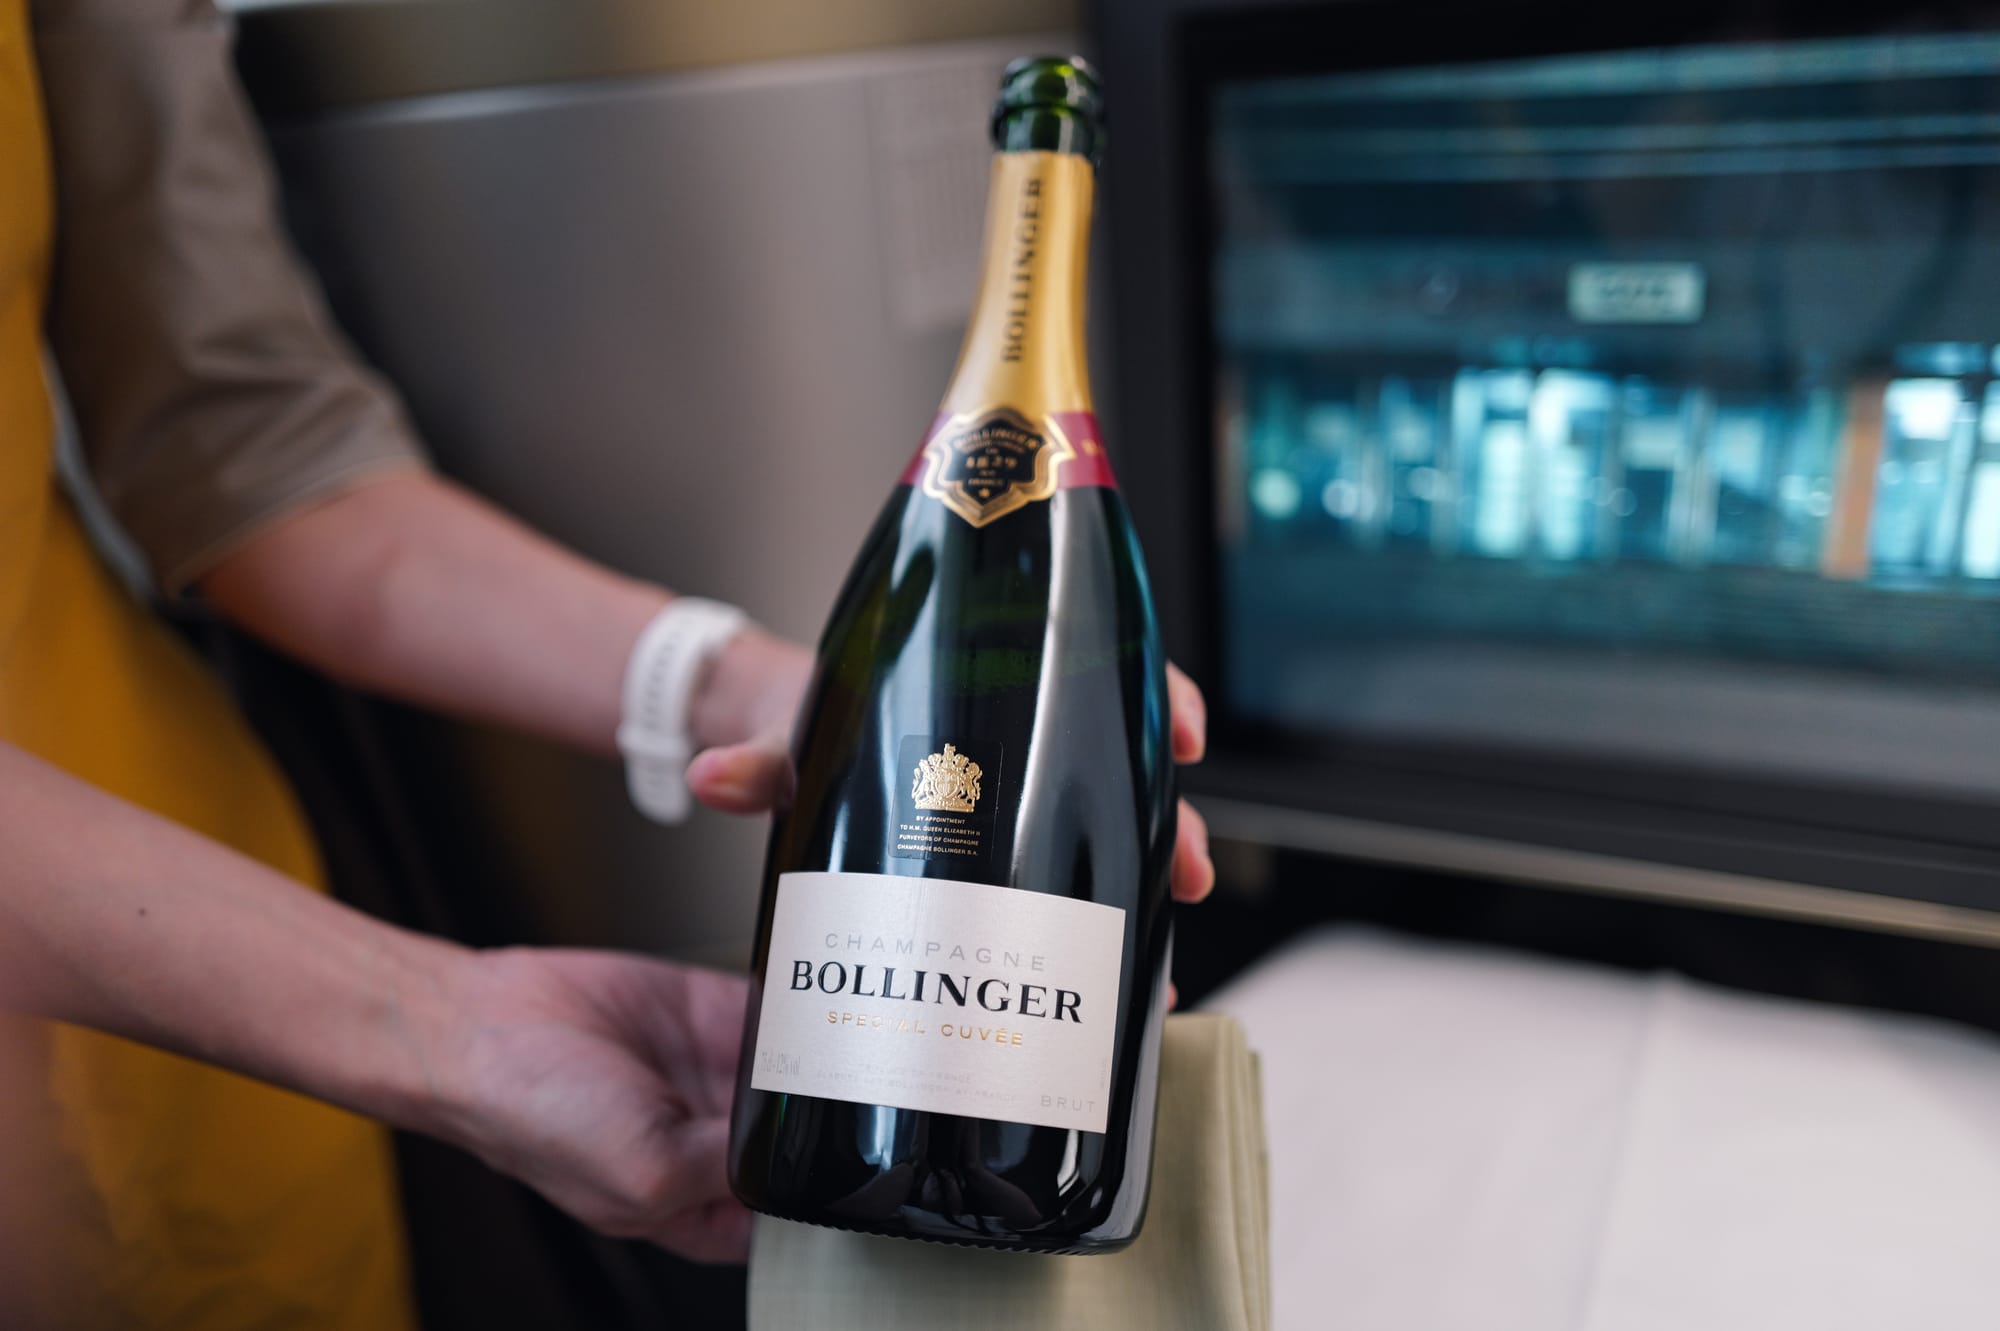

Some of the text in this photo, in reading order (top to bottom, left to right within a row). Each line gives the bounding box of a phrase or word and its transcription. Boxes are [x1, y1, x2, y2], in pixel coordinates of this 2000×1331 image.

[1001, 178, 1042, 363] BOLLINGER
[924, 816, 965, 825] APPOINTMENT
[899, 834, 932, 842] PURVEYORS
[943, 837, 979, 846] CHAMPAGNE
[943, 827, 975, 836] ELIZABETH
[897, 844, 932, 852] CHAMPAGNE
[933, 846, 966, 855] BOLLINGER
[825, 933, 1045, 972] CHAMPAGNE
[790, 960, 1084, 1024] BOLLINGER
[827, 1011, 1023, 1047] SPECIAL CUVÉE
[1040, 1094, 1096, 1113] BRUT
